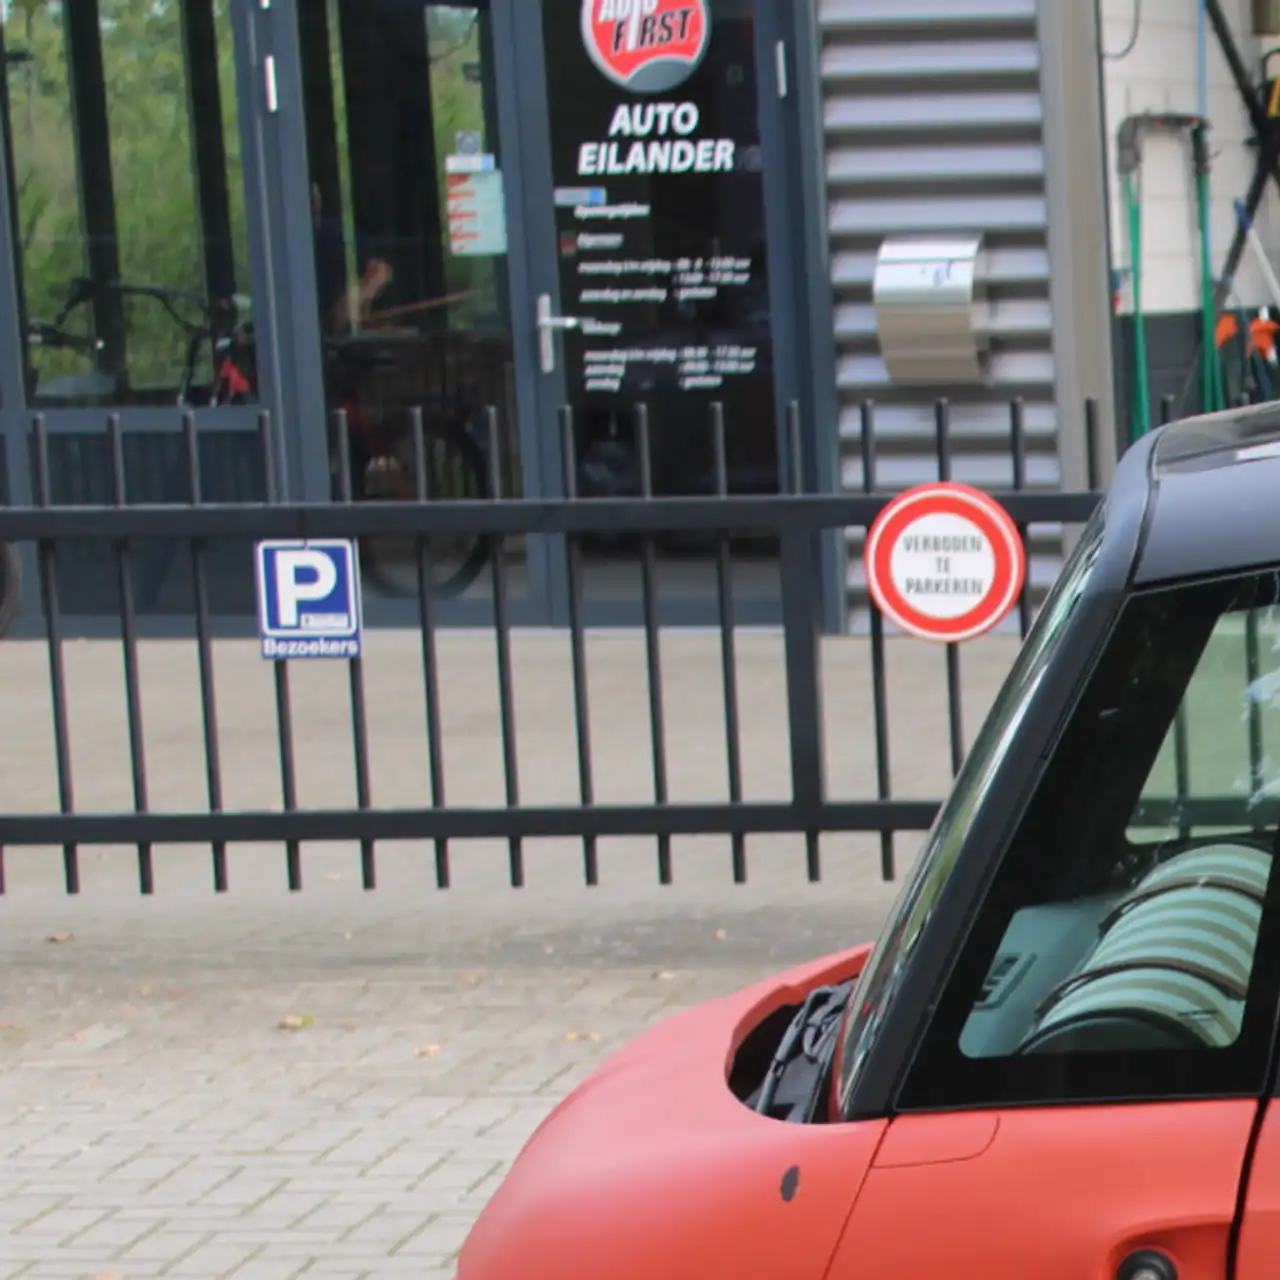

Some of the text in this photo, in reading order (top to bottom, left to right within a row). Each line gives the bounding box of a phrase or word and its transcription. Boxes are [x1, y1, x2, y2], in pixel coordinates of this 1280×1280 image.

[613, 7, 693, 53] FIRST
[609, 102, 699, 136] AUTO
[578, 138, 735, 175] EILANDER
[904, 535, 982, 552] VERBODEN
[936, 557, 950, 573] TE
[276, 550, 337, 626] P
[905, 578, 982, 594] PARKEREN
[263, 637, 358, 656] Bezoekers
